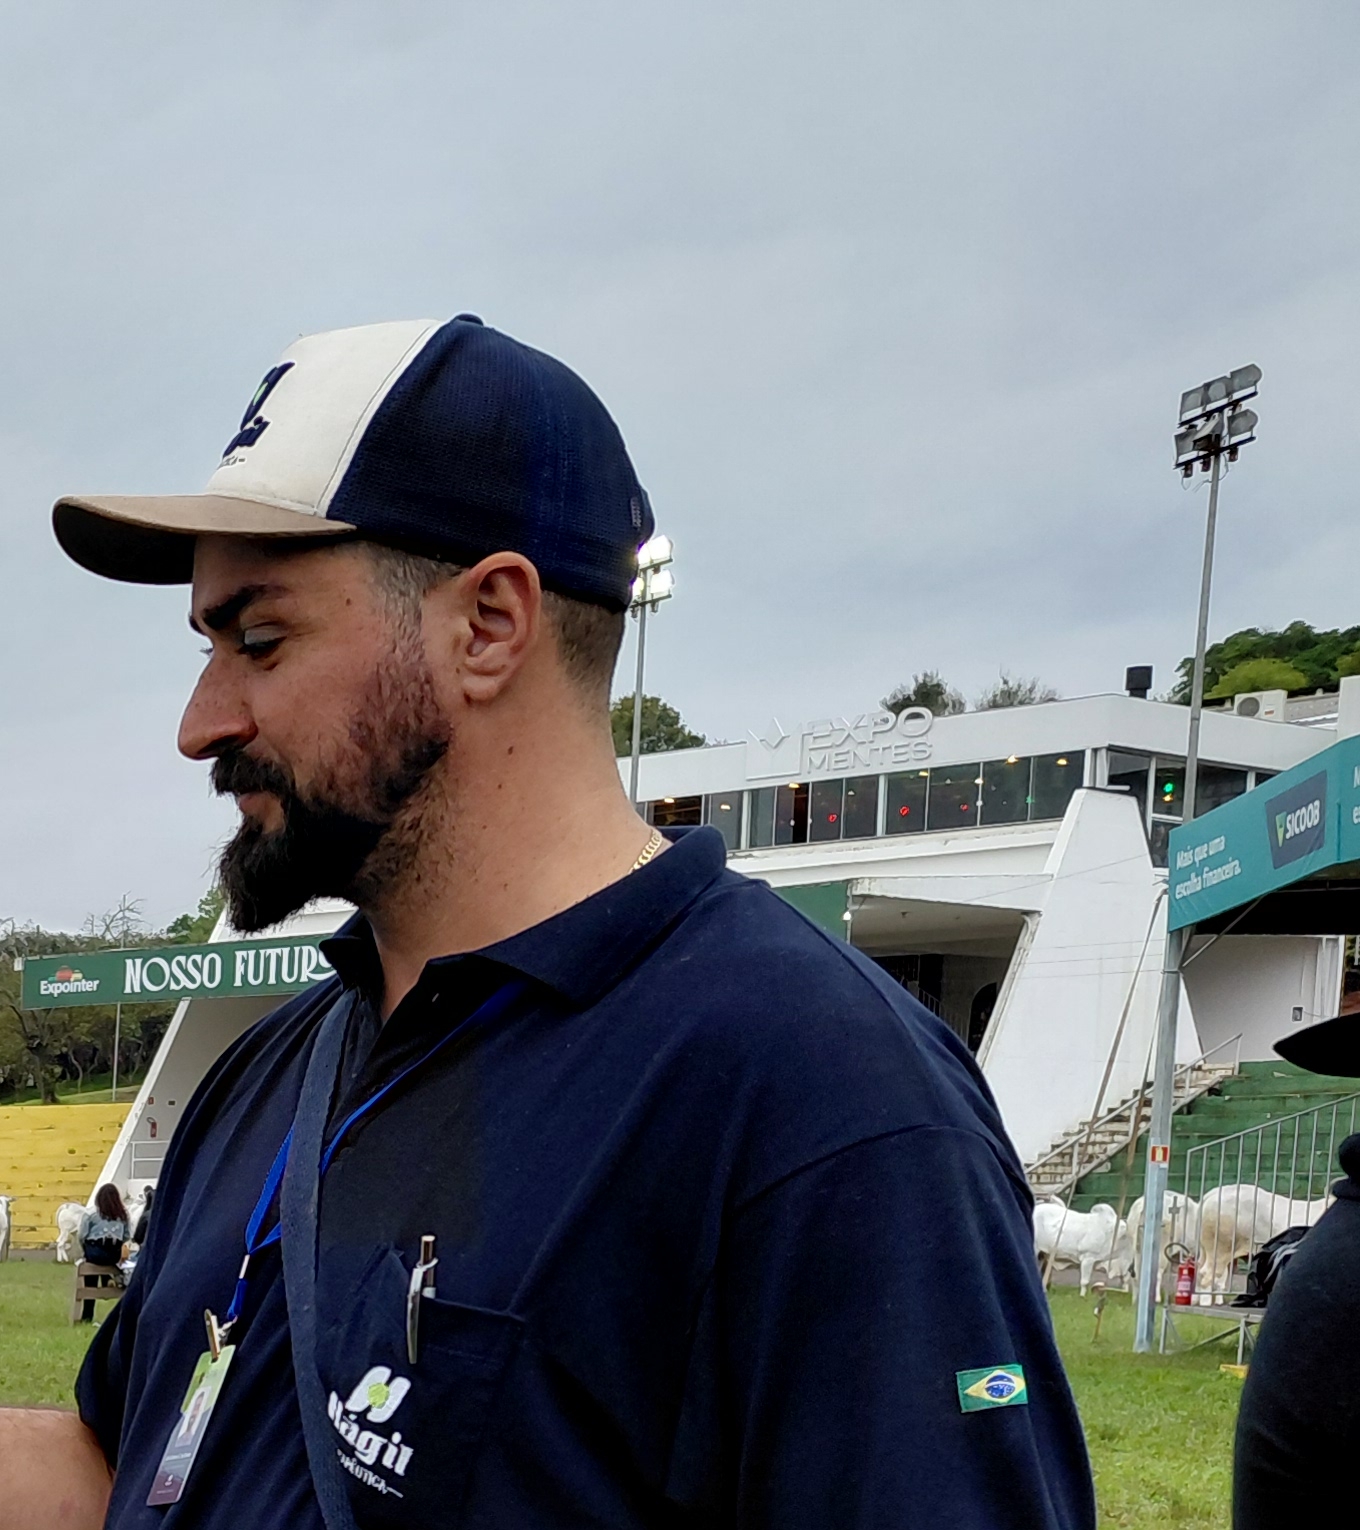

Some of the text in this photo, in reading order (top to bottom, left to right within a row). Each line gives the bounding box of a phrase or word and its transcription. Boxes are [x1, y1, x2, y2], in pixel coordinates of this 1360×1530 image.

[808, 706, 933, 751] EXPO
[807, 742, 933, 775] MENTES
[1285, 799, 1321, 840] SICOOB
[1176, 835, 1226, 871] Mais que uma
[1175, 872, 1202, 900] escolha
[39, 978, 99, 997] Expointer
[123, 952, 222, 994] NOSSO
